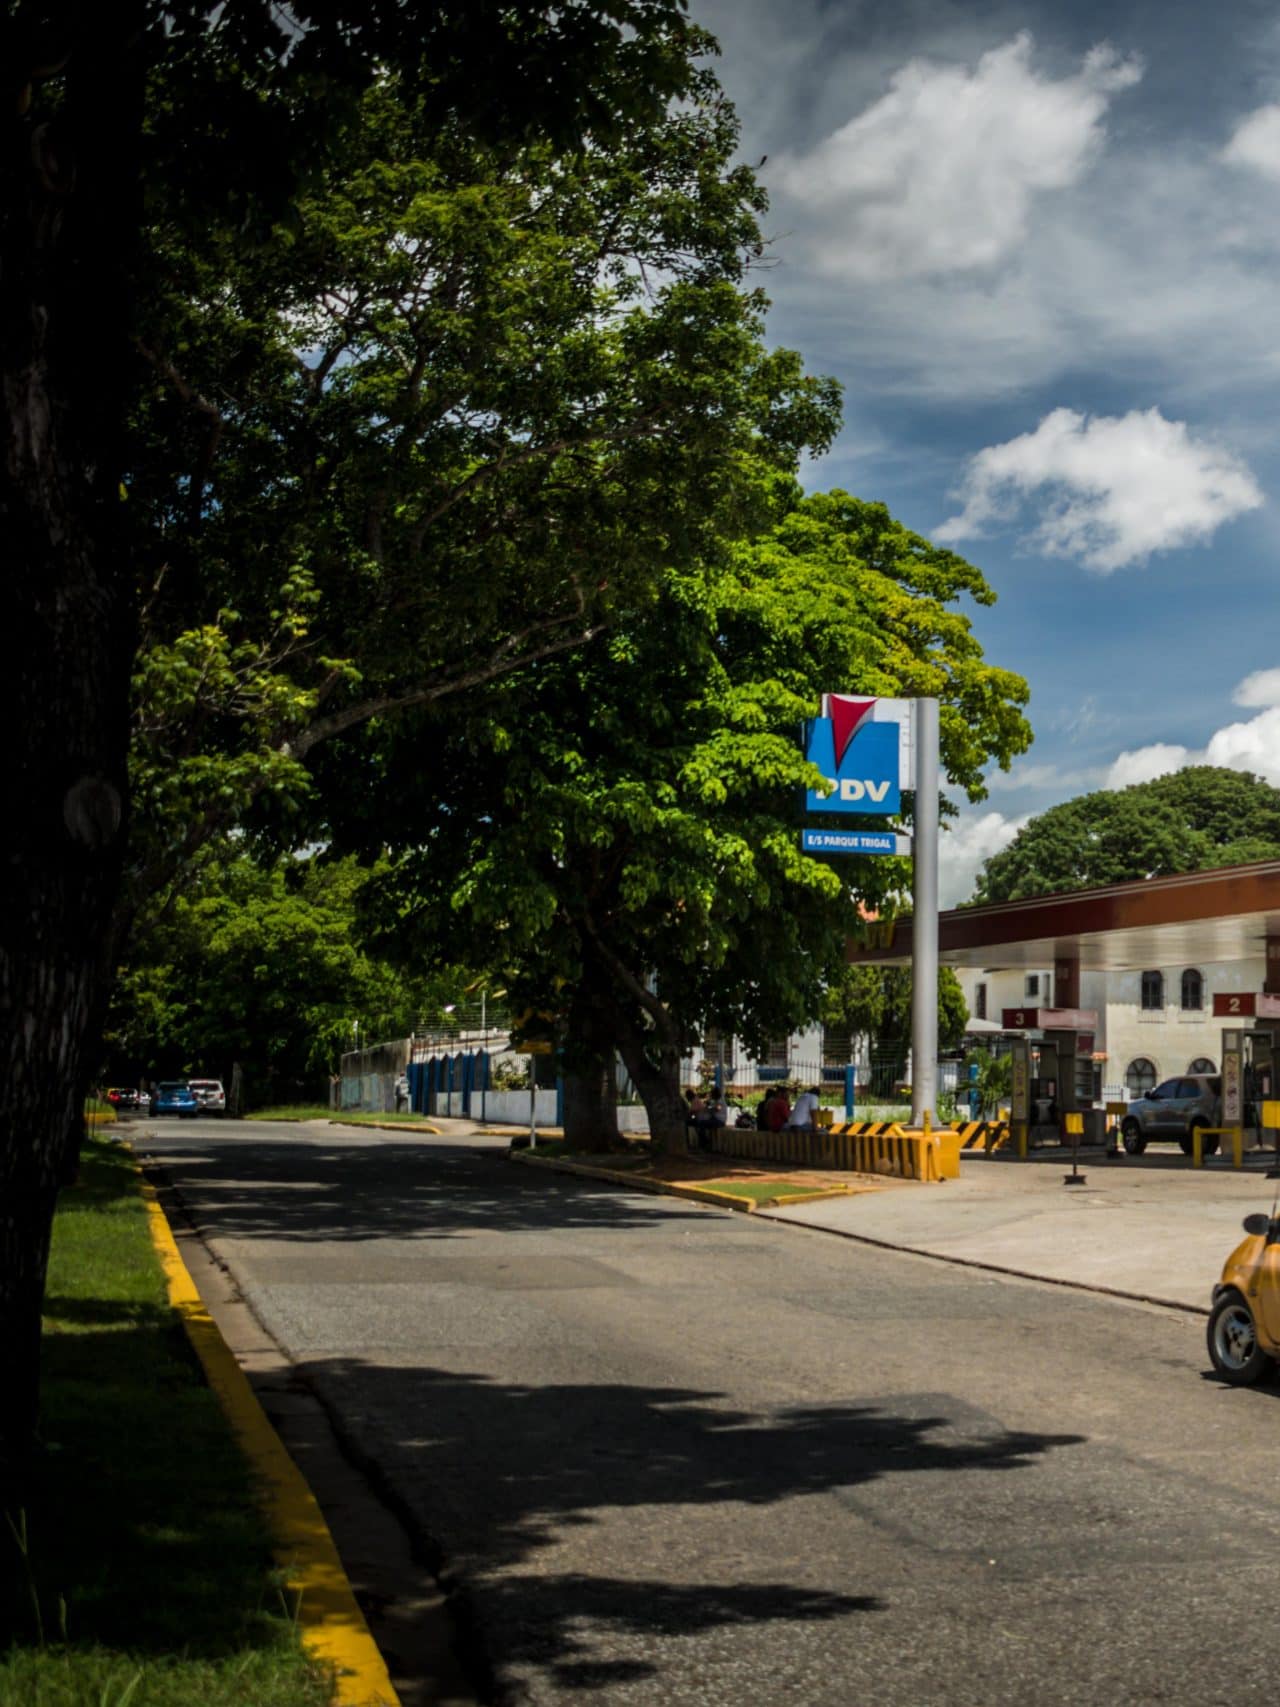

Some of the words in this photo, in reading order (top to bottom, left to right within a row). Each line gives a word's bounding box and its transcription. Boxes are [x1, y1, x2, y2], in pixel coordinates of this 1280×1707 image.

[808, 835, 823, 846] E/S
[824, 836, 859, 847] PARQUE
[860, 837, 891, 849] TRIGAL
[1229, 998, 1241, 1012] 2
[1015, 1012, 1025, 1026] 3
